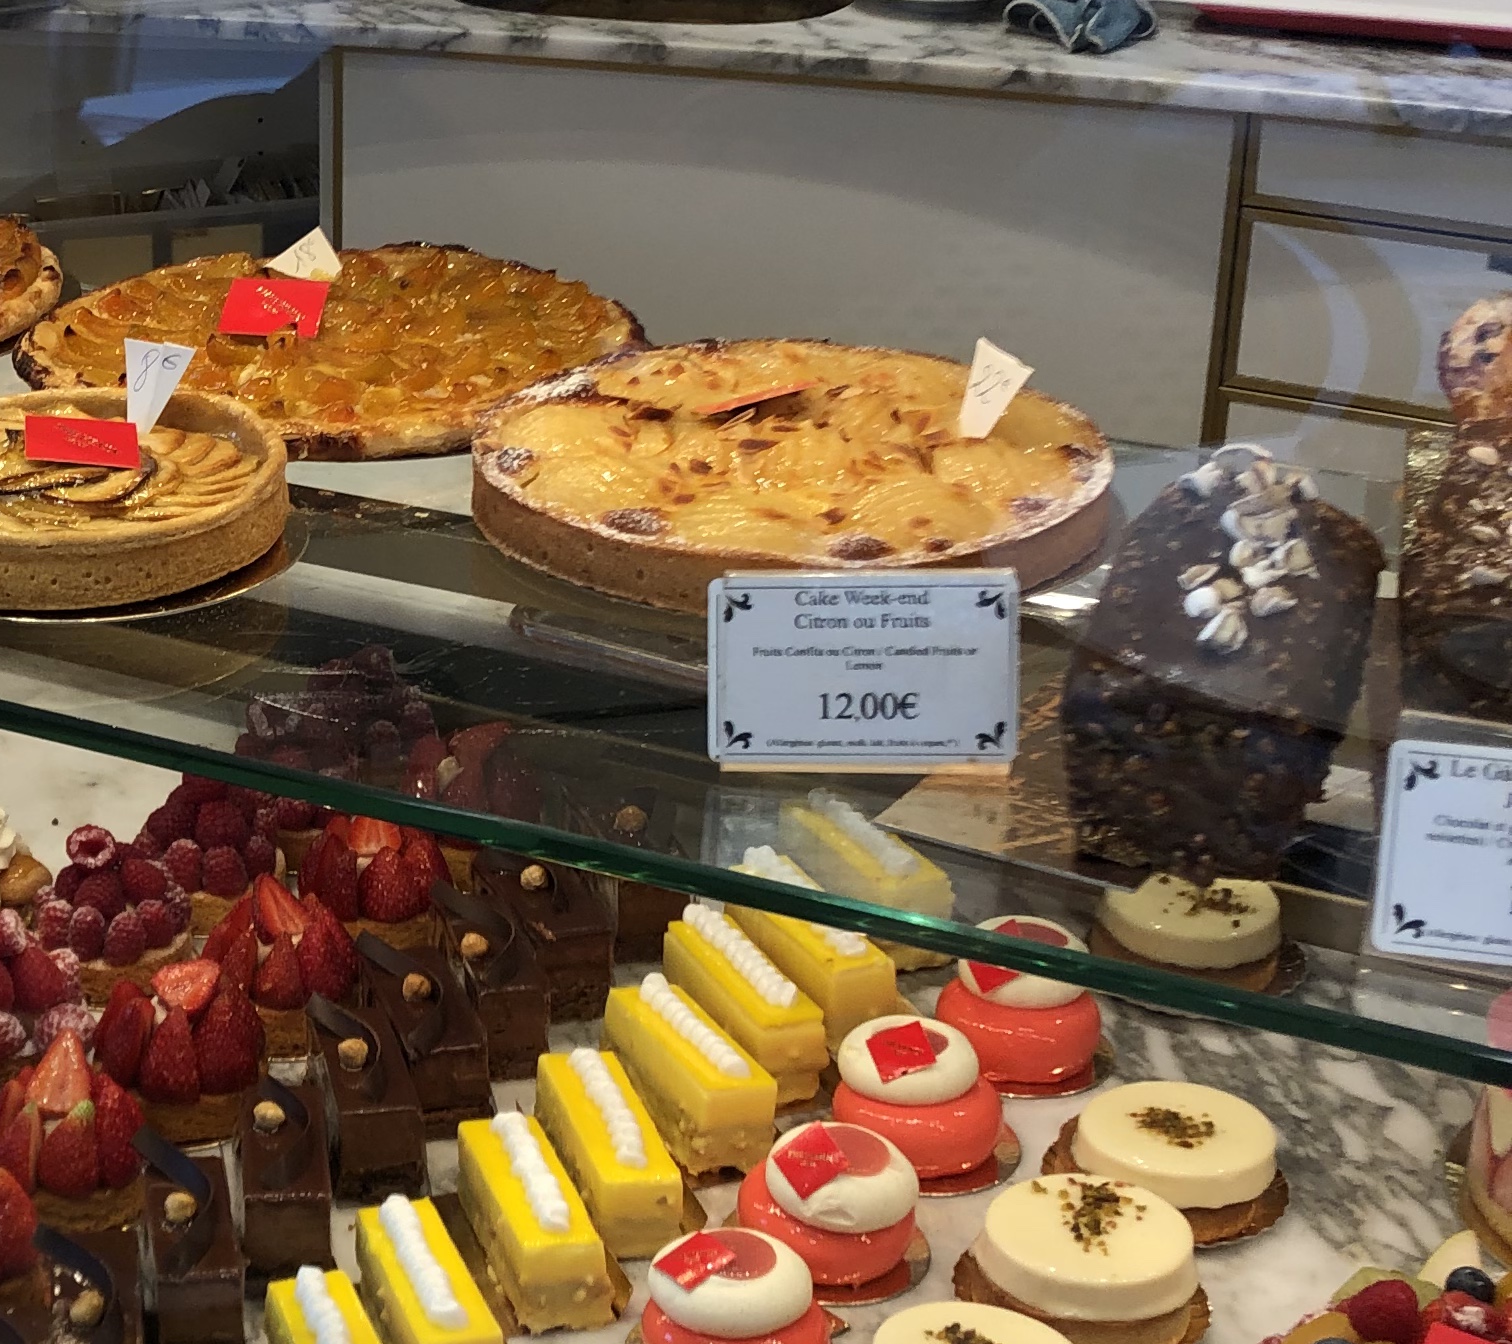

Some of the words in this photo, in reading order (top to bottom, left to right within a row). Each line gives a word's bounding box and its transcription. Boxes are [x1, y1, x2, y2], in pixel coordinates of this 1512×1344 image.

[794, 590, 839, 606] Cake
[844, 590, 930, 605] Week-end
[794, 613, 848, 629] Citron
[853, 617, 876, 629] ou
[880, 613, 931, 628] Fruits
[820, 692, 920, 721] 12,00€
